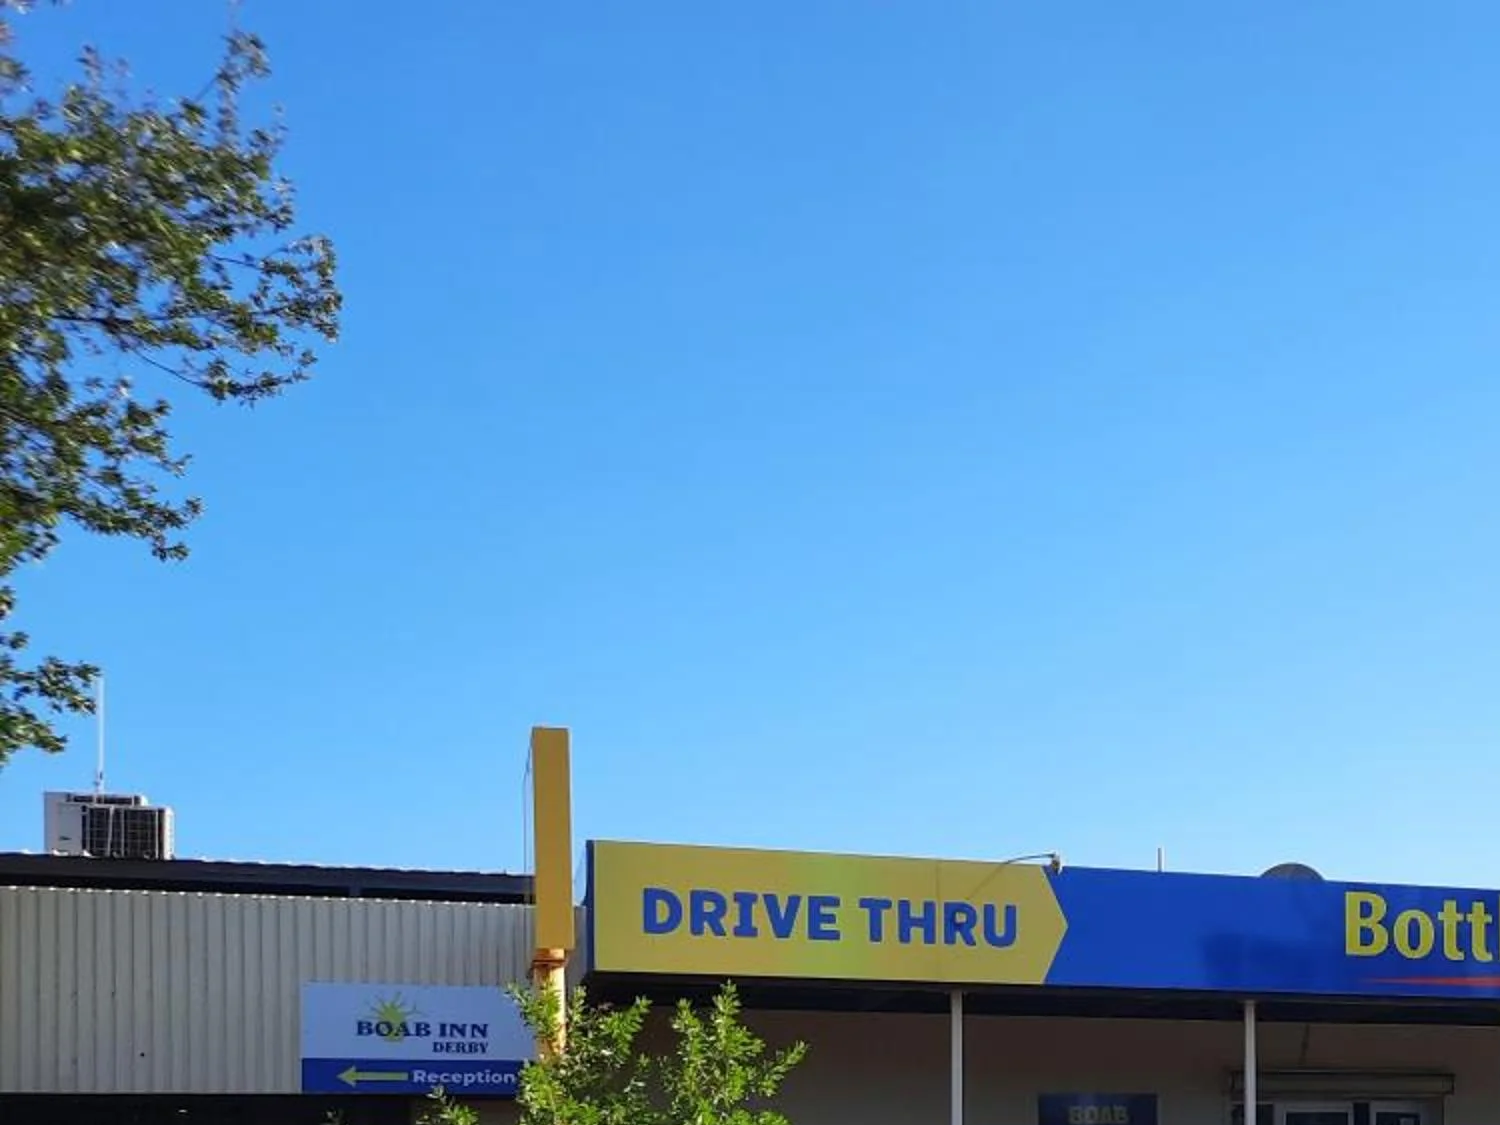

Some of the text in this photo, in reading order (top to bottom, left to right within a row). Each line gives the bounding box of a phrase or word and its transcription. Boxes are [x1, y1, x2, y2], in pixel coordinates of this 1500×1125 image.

[641, 887, 1018, 948] DRIVE THRU
[356, 1020, 489, 1039] BOAB INN
[432, 1041, 489, 1054] DERBY
[413, 1069, 516, 1087] Reception
